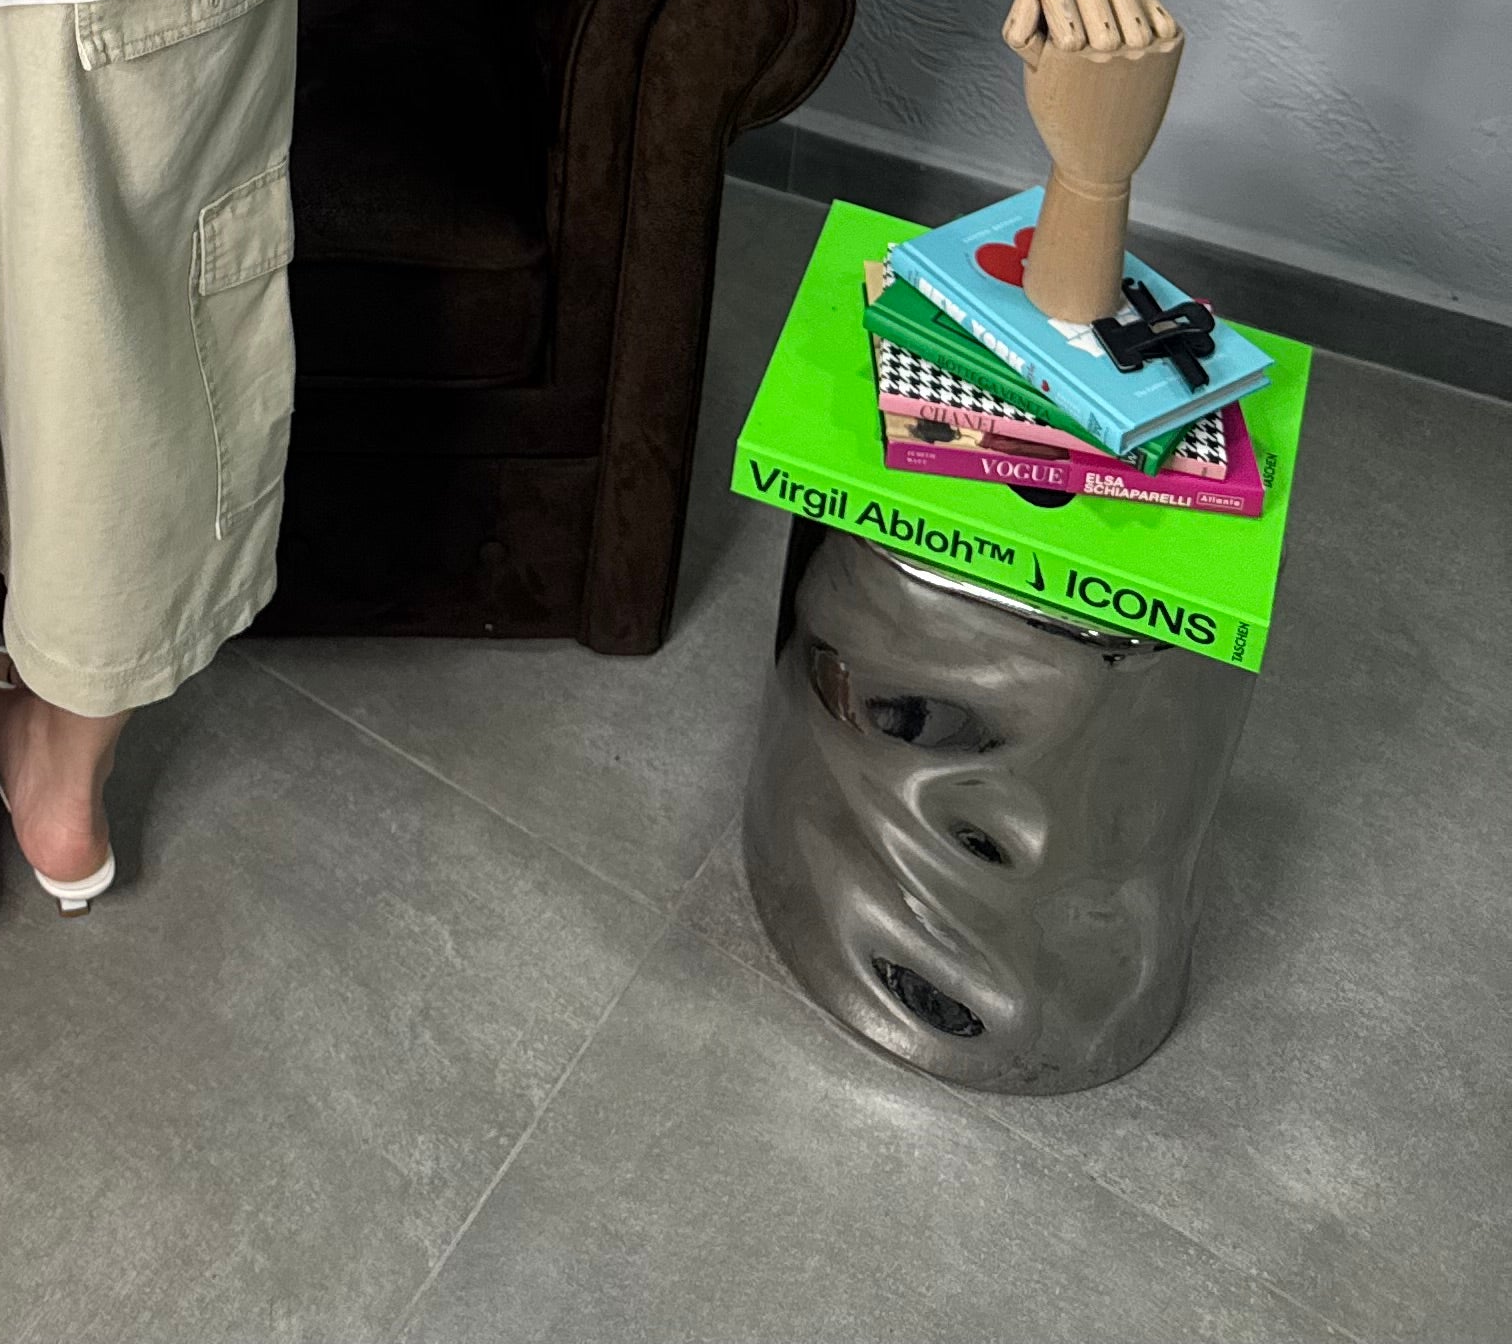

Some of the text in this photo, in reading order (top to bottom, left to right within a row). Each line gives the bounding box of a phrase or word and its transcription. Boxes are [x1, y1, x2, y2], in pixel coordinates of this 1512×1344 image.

[971, 318, 1026, 373] YORK
[919, 404, 1001, 434] CHANEL
[980, 458, 1064, 485] VOGUE
[1085, 472, 1125, 488] ELSA
[1083, 482, 1192, 507] SCHIAPARELLI
[749, 459, 848, 519] Virgil
[1065, 569, 1217, 645] ICONS
[1231, 621, 1250, 663] TASCHEN
